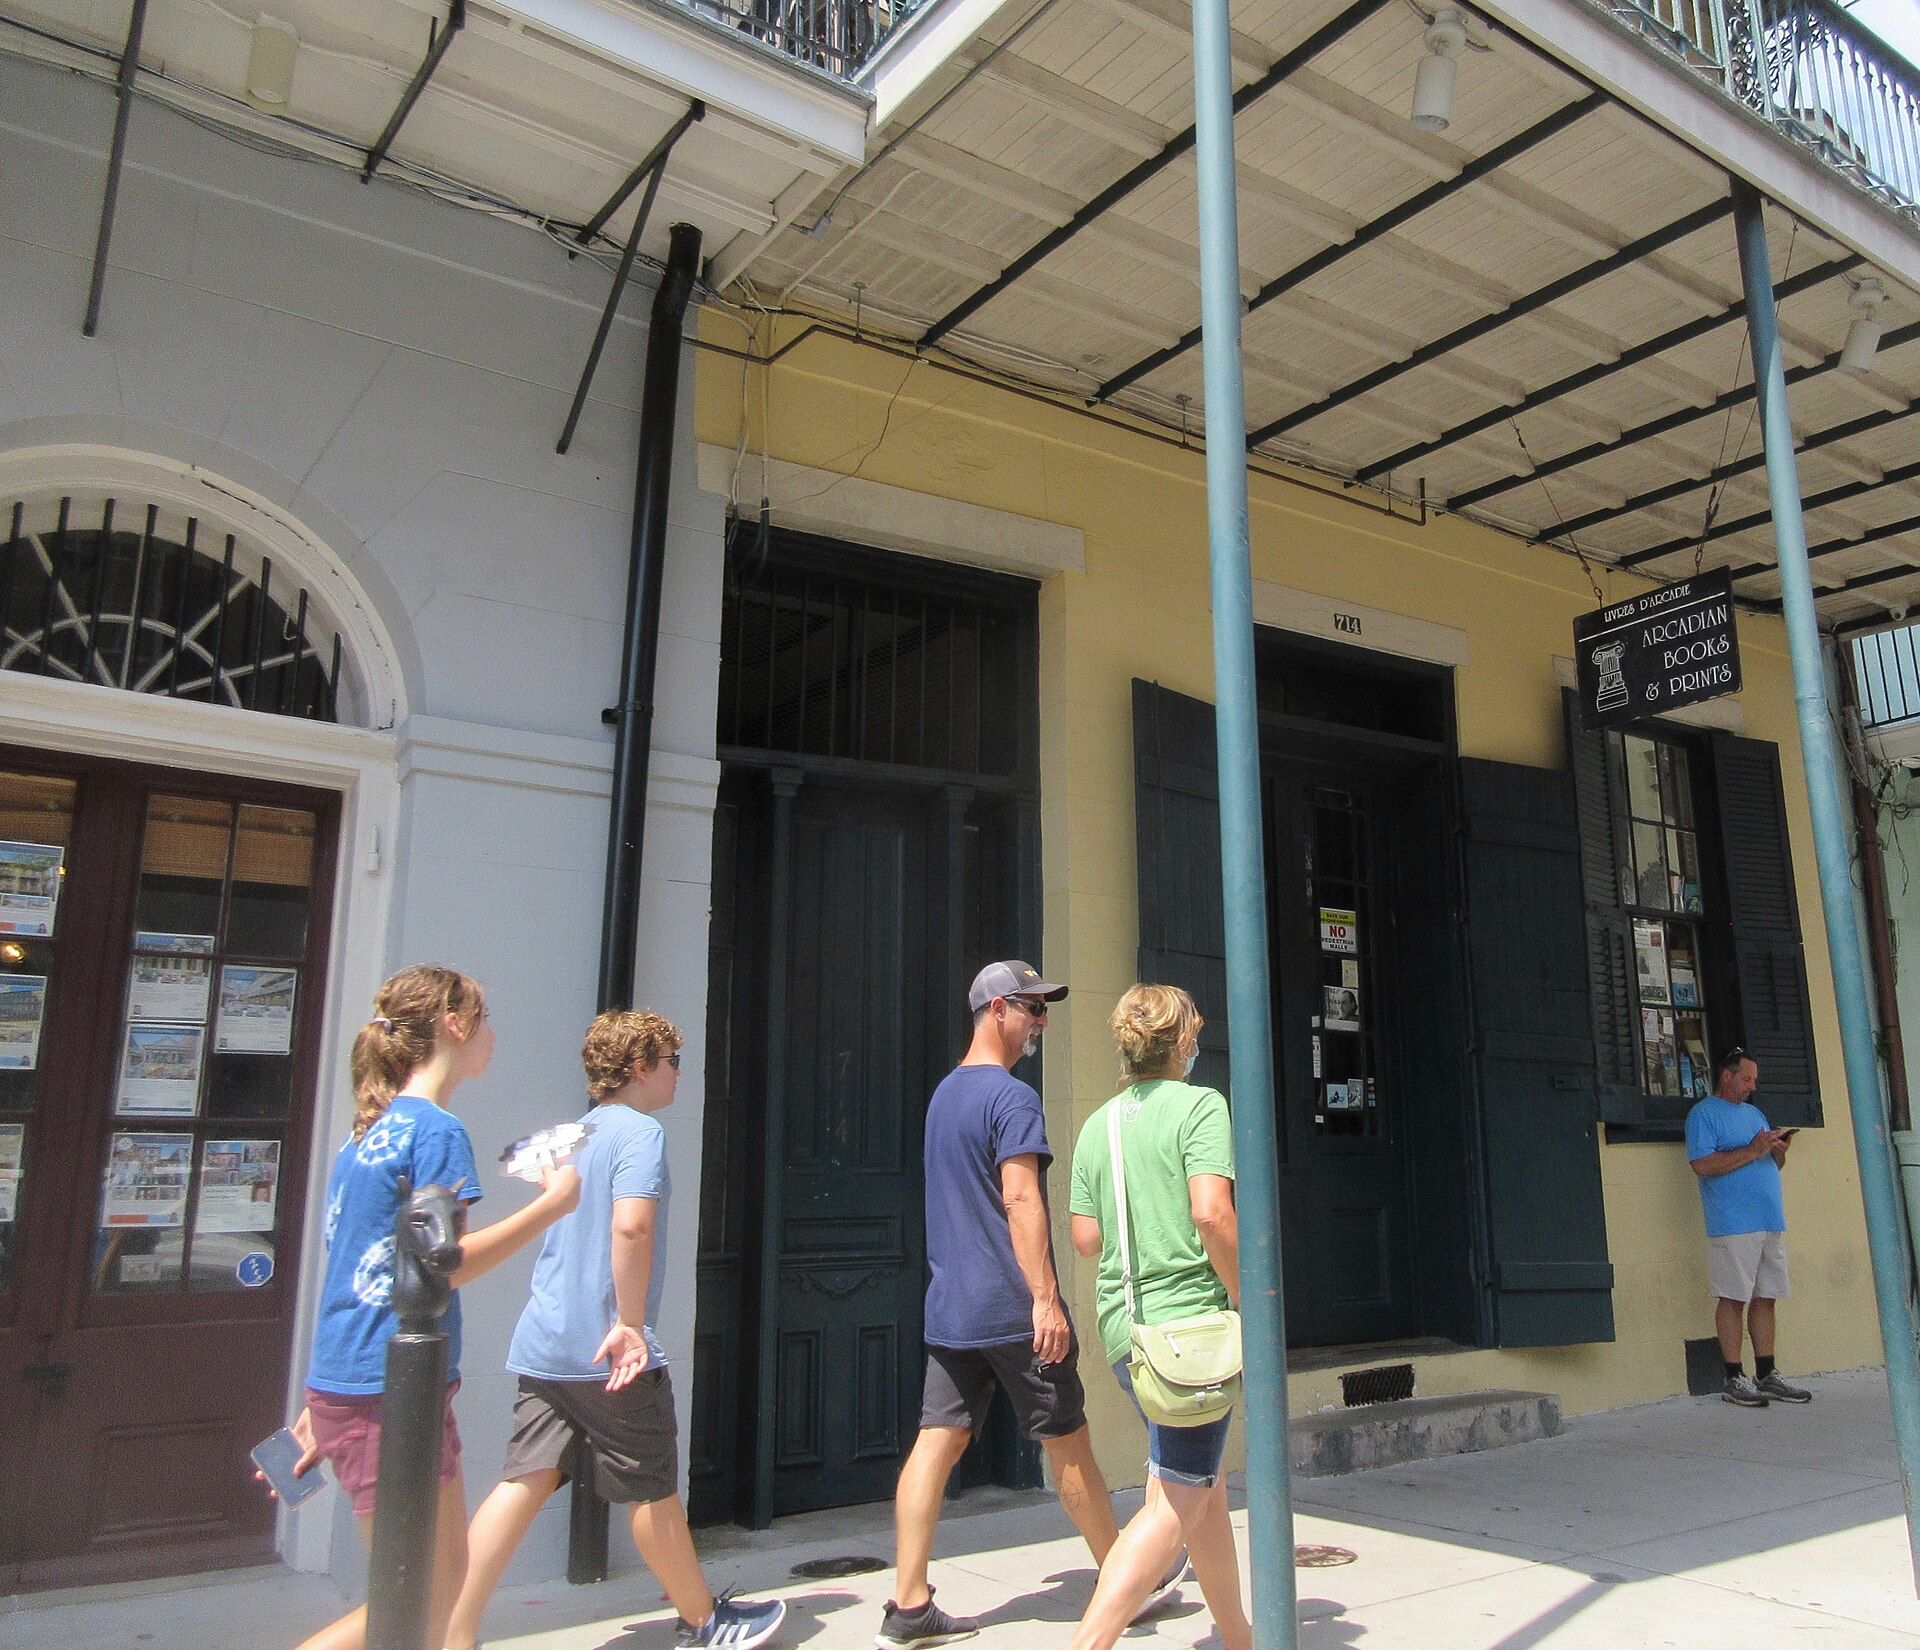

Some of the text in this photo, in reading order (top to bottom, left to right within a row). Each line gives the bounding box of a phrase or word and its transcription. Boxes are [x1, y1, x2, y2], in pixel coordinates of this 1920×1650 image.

[1604, 584, 1691, 623] LIVRES D'ARCADIE
[1336, 614, 1360, 635] 714
[1642, 604, 1728, 648] ARCADIAN
[1663, 634, 1730, 670] BOOKS
[1645, 663, 1732, 701] & PRINTS
[1329, 925, 1347, 938] NO
